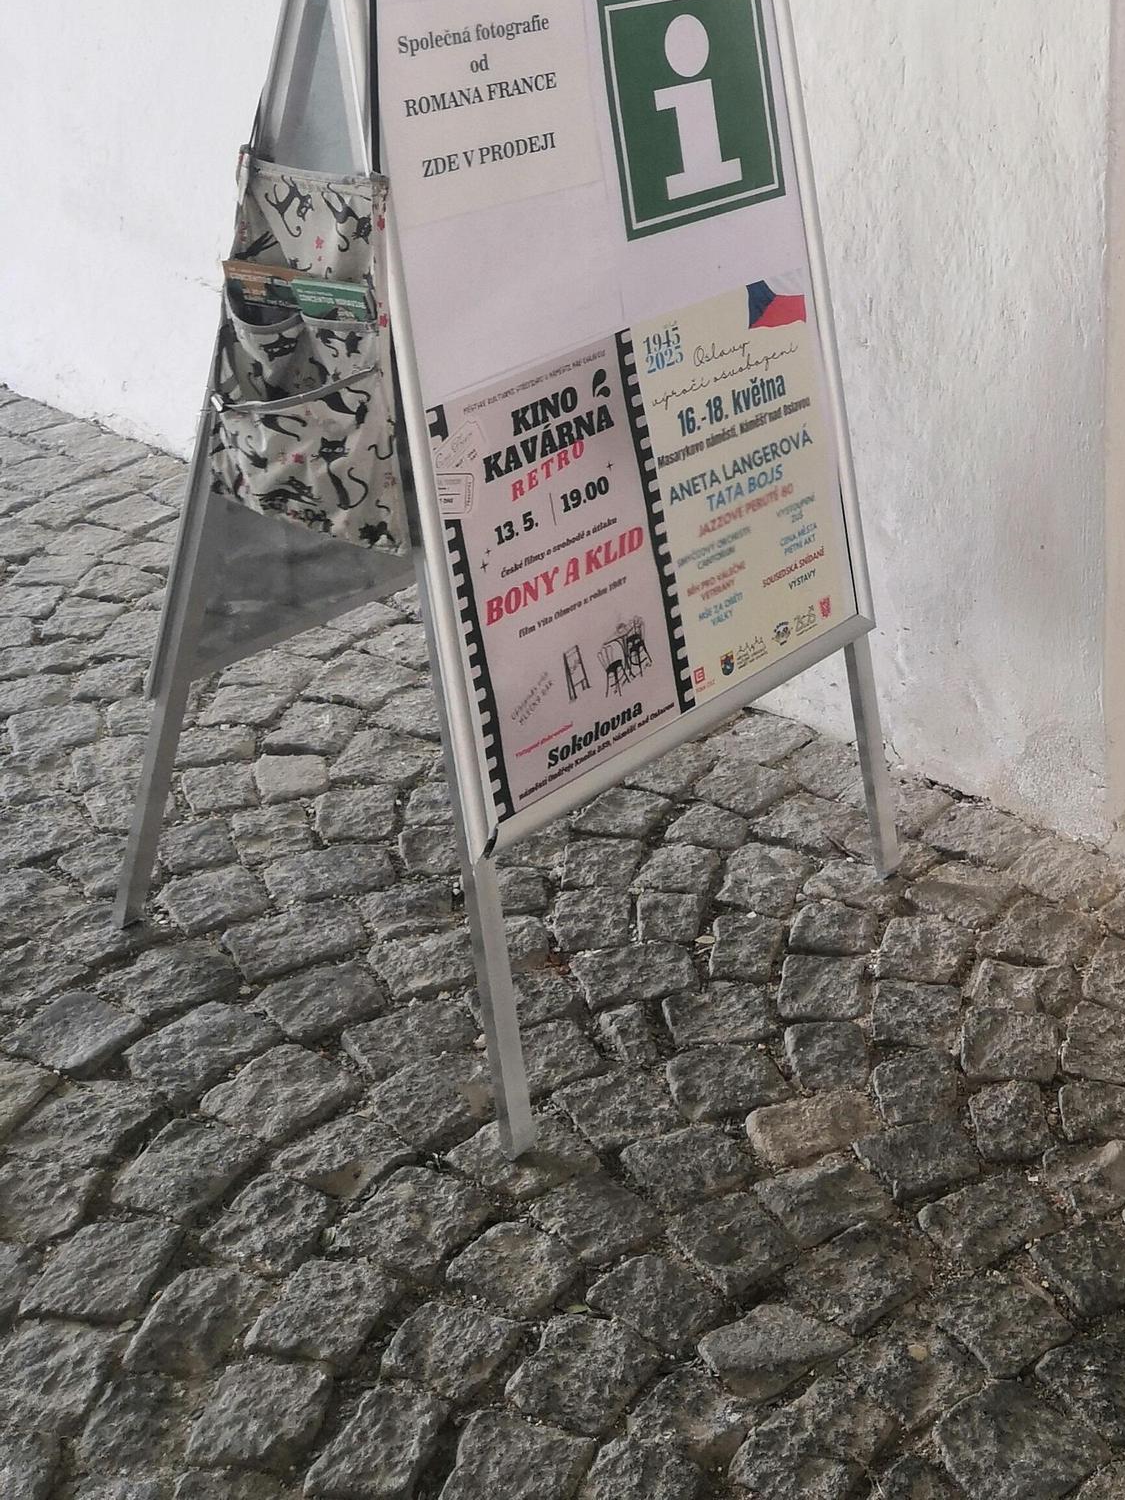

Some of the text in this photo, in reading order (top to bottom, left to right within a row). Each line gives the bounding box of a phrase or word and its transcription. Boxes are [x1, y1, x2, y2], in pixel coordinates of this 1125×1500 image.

[397, 14, 550, 57] Společná fotografie
[470, 53, 490, 73] od
[404, 72, 557, 117] ROMANA FRANCE
[422, 132, 556, 178] ZDE V PRODEJI
[643, 326, 681, 355] 1945
[645, 346, 683, 374] 2025
[693, 341, 750, 368] Oslavy
[511, 386, 578, 436] KINO
[732, 374, 786, 415] května
[482, 404, 615, 483] KAVÁRNA
[657, 440, 704, 469] Masarykovo
[670, 423, 813, 506] ANETA LANGEROVÁ
[511, 439, 585, 502] RETRO
[706, 463, 784, 512] TATA BOJS
[494, 476, 610, 546] 13. 5. 19.00
[486, 526, 644, 626] BONY A KLID
[500, 560, 523, 578] České
[524, 552, 545, 568] filmy
[547, 701, 643, 769] Sokolovna
